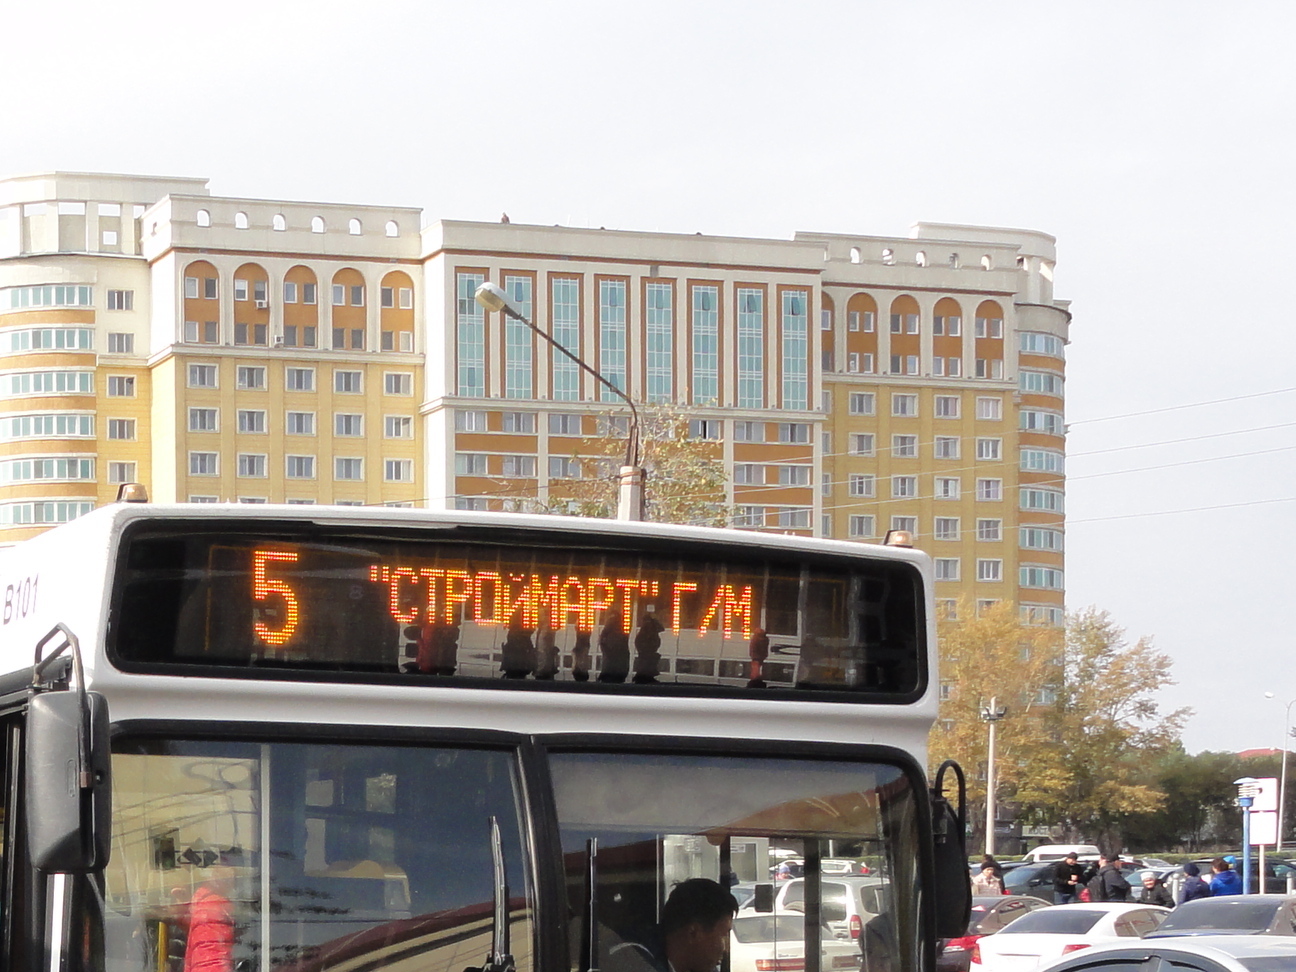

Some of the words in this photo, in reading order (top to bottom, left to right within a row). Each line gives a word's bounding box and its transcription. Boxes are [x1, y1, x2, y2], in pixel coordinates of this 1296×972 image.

[3, 573, 38, 625] B101
[254, 550, 298, 645] 5
[673, 581, 752, 640] Г/М
